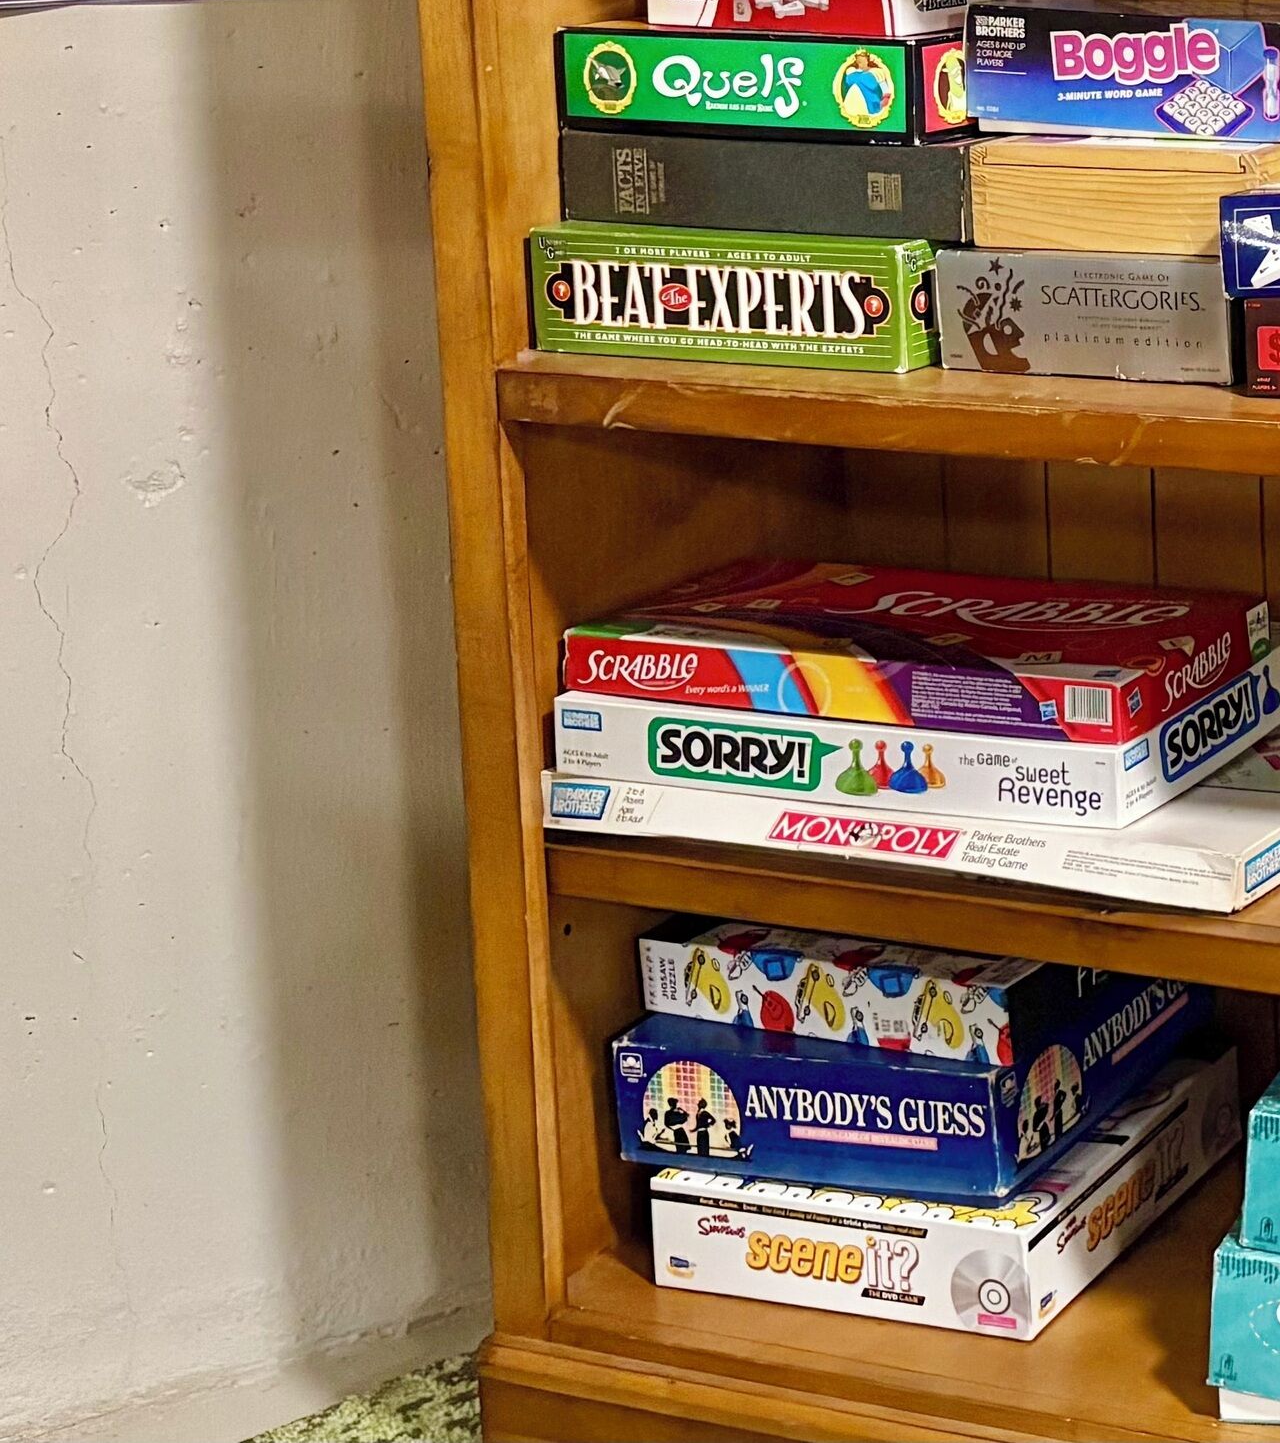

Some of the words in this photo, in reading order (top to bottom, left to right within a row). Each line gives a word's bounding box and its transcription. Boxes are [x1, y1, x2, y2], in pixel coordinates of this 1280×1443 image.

[1050, 22, 1220, 86] Boggle
[652, 54, 804, 118] Quelf
[1058, 90, 1102, 100] 3-MINUTE
[1104, 89, 1132, 99] WORD
[1136, 88, 1162, 97] GAME
[571, 259, 671, 328] BEAT
[660, 284, 688, 306] The
[688, 265, 869, 337] EXPERTS
[596, 333, 620, 341] GAME
[624, 334, 655, 343] WHERE
[659, 336, 677, 344] YOU
[681, 337, 693, 345] GO
[772, 342, 797, 351] WITH
[800, 344, 818, 352] THE
[822, 345, 864, 354] EXPERTS
[577, 650, 698, 690] SCRABBLE
[685, 685, 704, 694] Every
[707, 685, 729, 693] word's
[738, 684, 769, 693] WINNER
[661, 728, 806, 778] SORRY!
[1015, 763, 1071, 786] sweet
[998, 777, 1101, 816] Revenge
[771, 811, 960, 856] MONOPOLY
[966, 842, 986, 853] Real
[988, 845, 1019, 856] Estate
[971, 830, 1002, 843] Parker
[1004, 833, 1046, 848] Brothers
[962, 853, 996, 868] Trading
[998, 857, 1028, 870] Game
[745, 1085, 892, 1130] ANYBODY'S
[899, 1102, 985, 1138] GUESS
[745, 1231, 863, 1283] scene
[865, 1235, 919, 1292] it?
